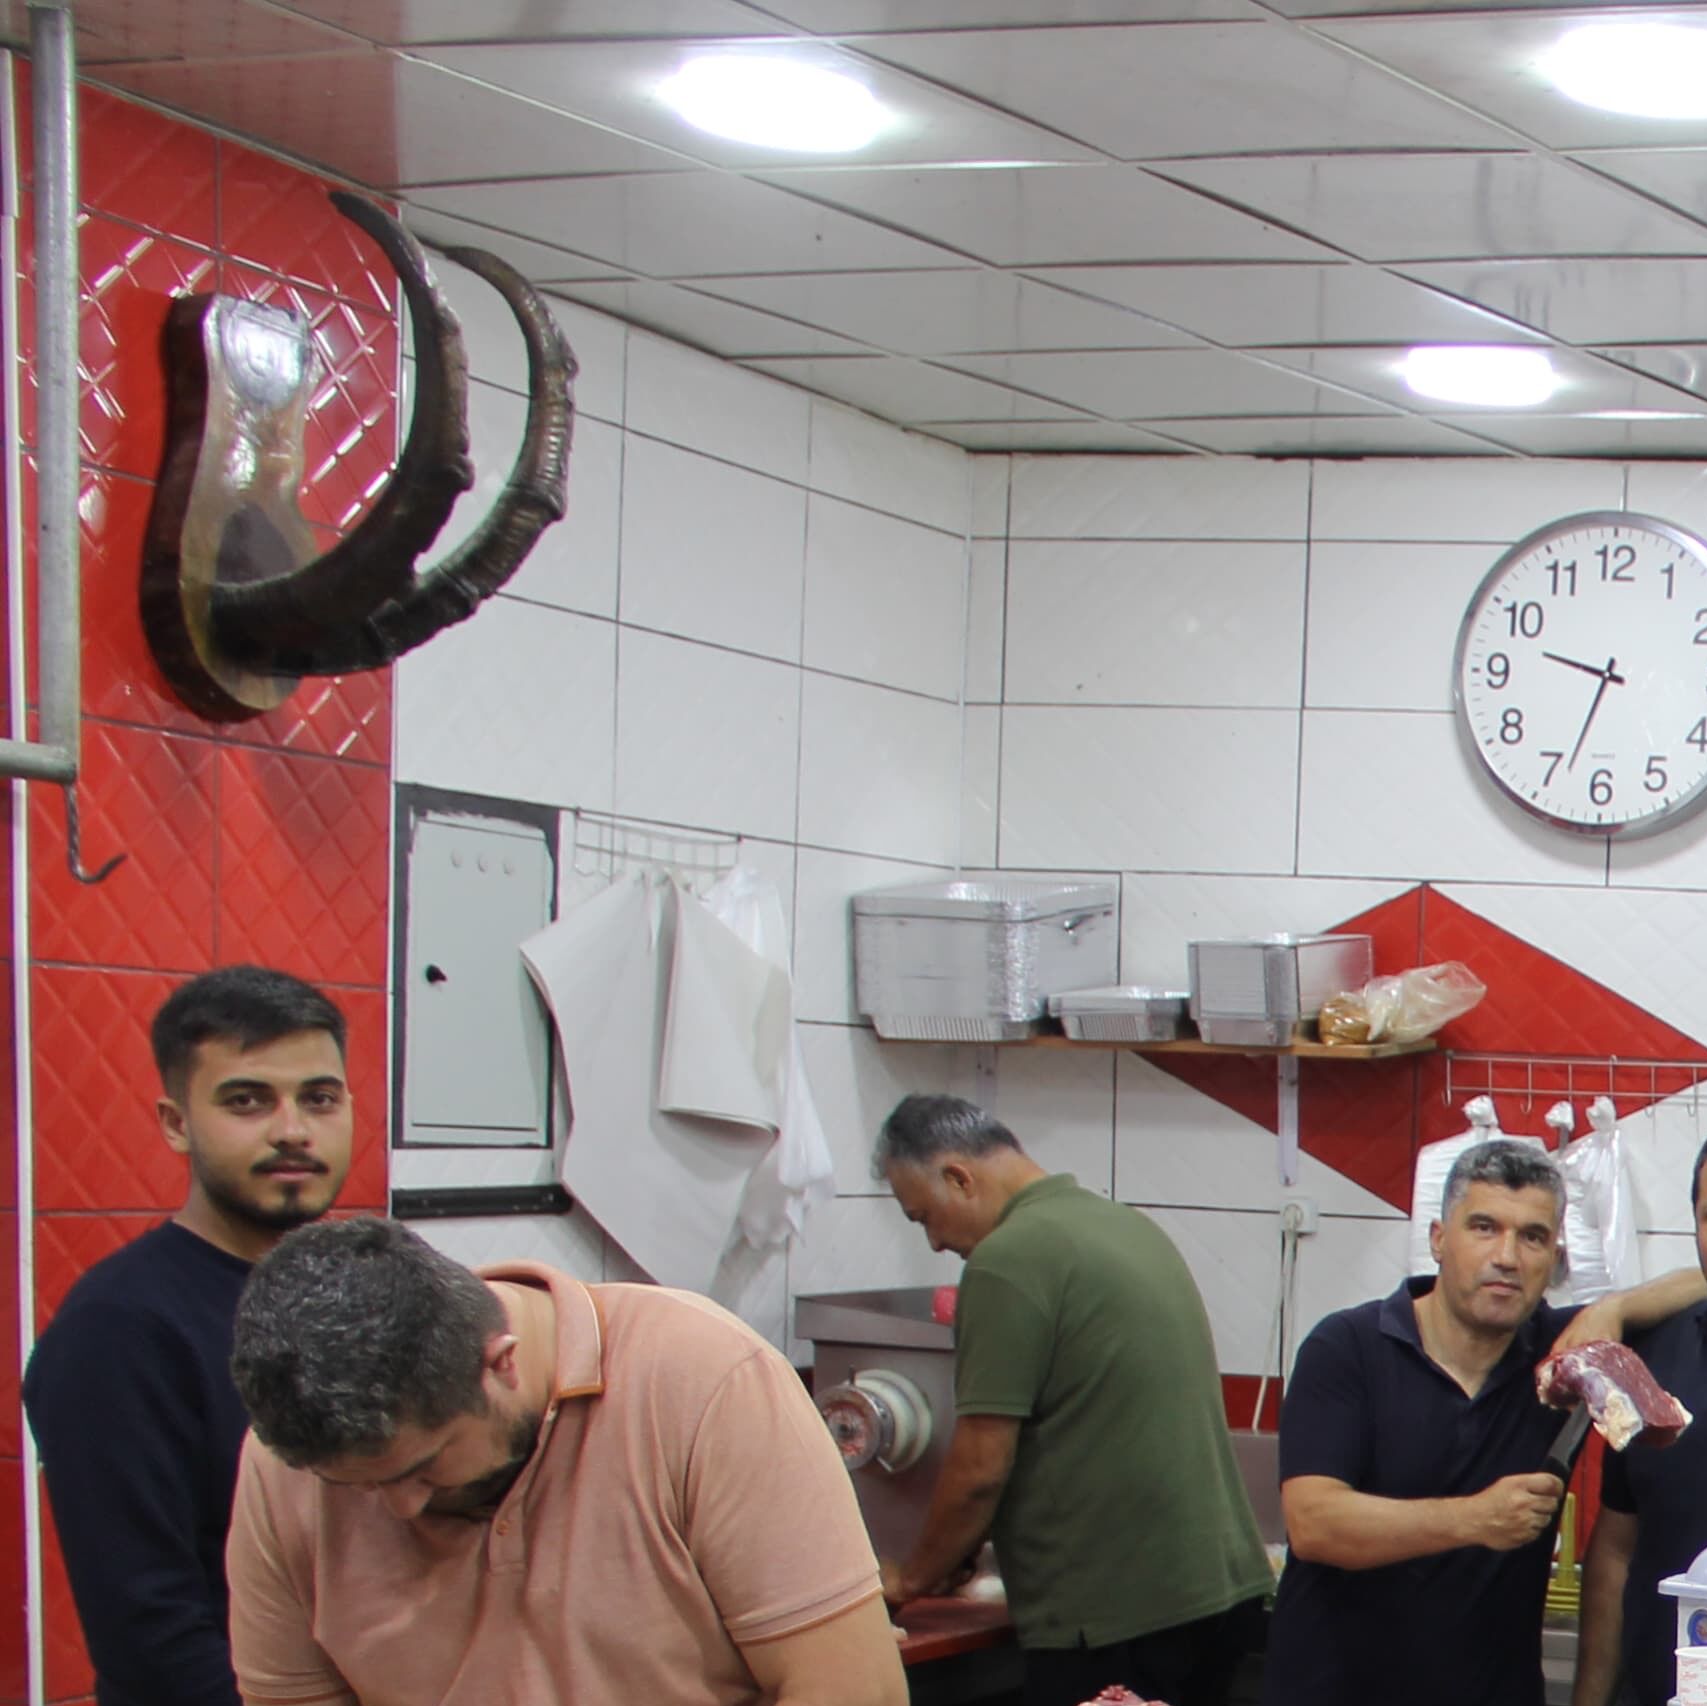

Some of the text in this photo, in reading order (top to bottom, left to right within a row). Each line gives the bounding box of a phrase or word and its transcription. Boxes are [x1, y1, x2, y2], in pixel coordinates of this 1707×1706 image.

[1545, 559, 1577, 596] 11
[1594, 544, 1637, 582] 12
[1660, 563, 1674, 600] 1
[1504, 601, 1544, 639] 10
[1486, 652, 1511, 690] 9
[1499, 708, 1524, 745] 8
[1539, 751, 1564, 788] 7
[1589, 769, 1614, 806] 6
[1643, 756, 1669, 793] 5
